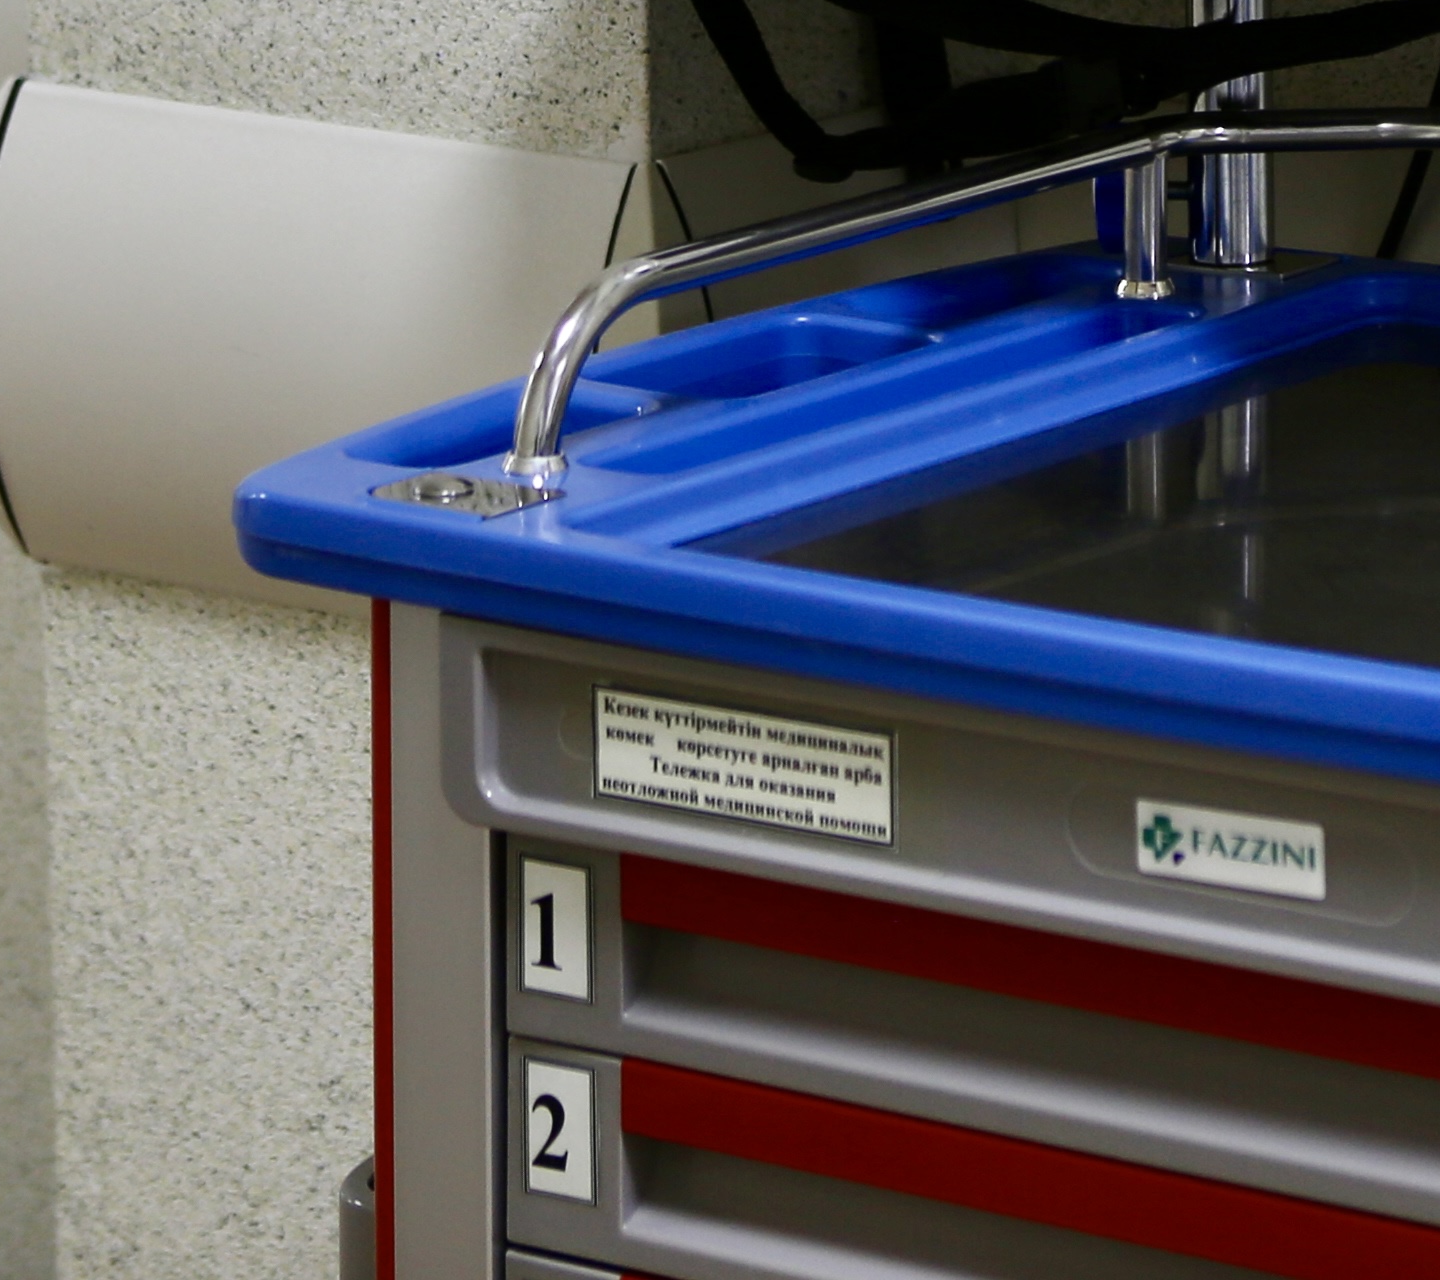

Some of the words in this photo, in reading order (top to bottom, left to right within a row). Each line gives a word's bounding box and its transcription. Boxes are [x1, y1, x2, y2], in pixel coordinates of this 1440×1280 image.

[604, 696, 650, 722] Кезек
[602, 776, 699, 806] неотложной
[704, 796, 815, 828] медицинской
[819, 813, 888, 839] помощи
[650, 756, 720, 785] Тележка
[725, 772, 754, 790] для
[759, 779, 836, 804] оказания
[1191, 827, 1317, 872] FAZZINI
[530, 892, 563, 972] 1
[531, 1093, 569, 1173] 2
